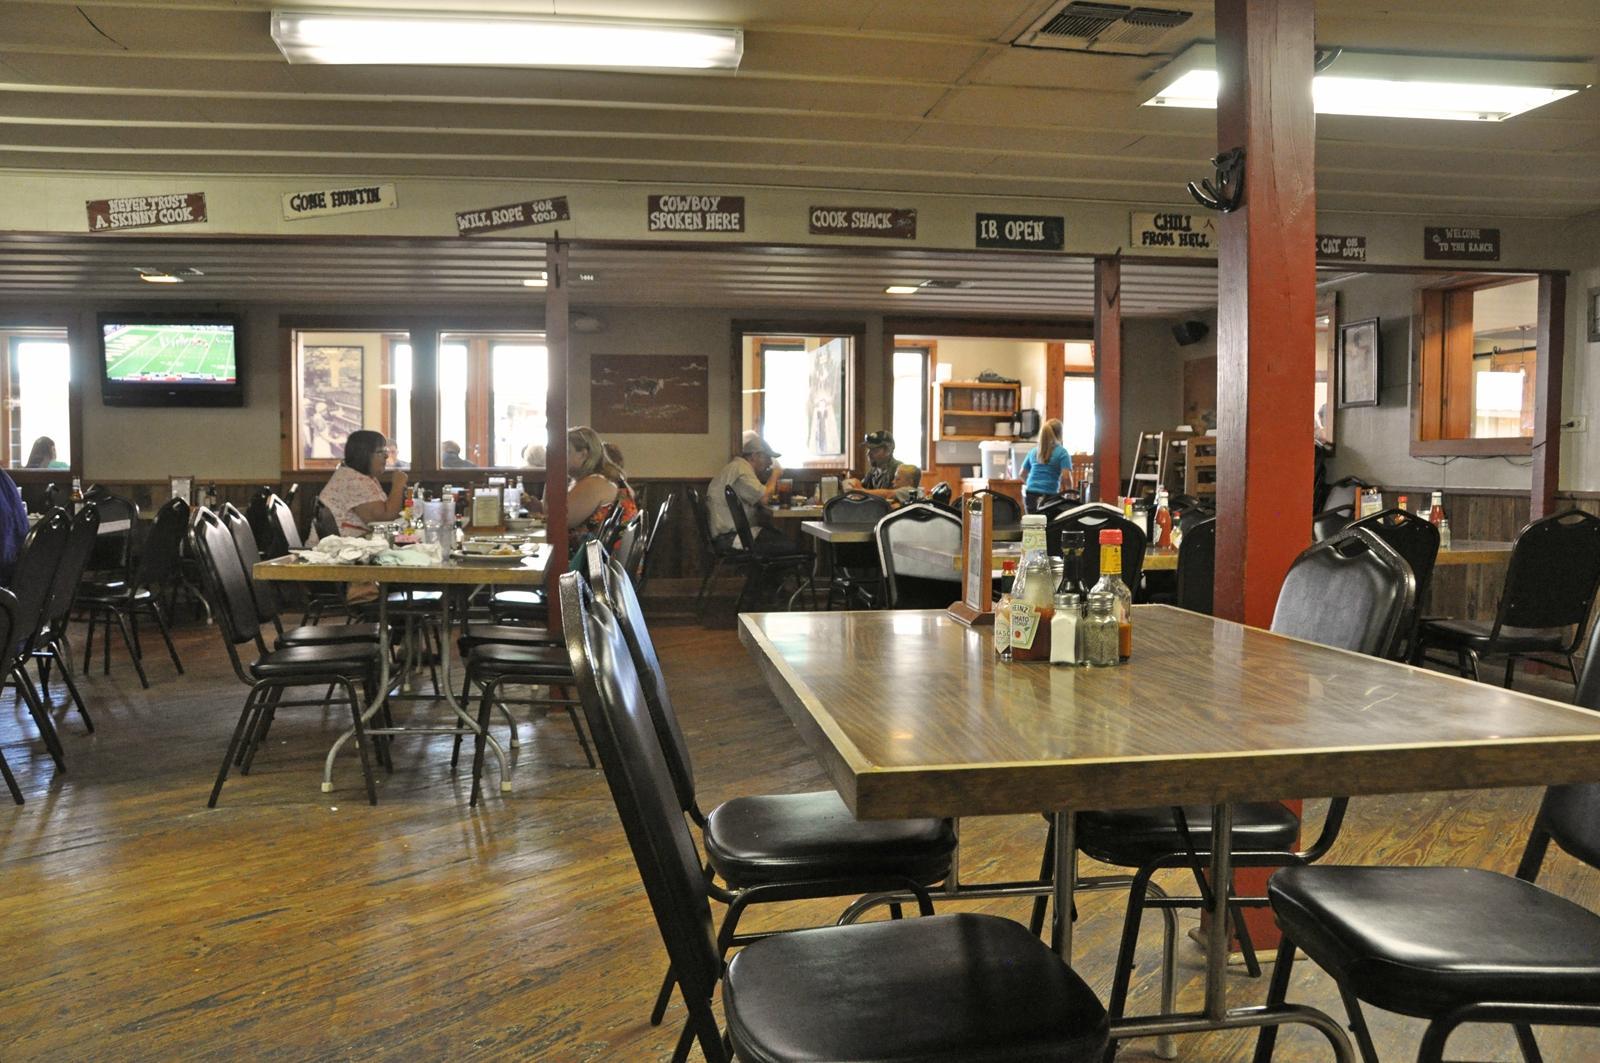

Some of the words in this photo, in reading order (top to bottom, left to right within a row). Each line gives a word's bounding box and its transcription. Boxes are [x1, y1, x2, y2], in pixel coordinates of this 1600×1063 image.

[108, 197, 149, 213] NEVER
[148, 194, 188, 211] TRUST
[290, 192, 327, 212] GONE
[330, 187, 381, 208] HUNTIN
[532, 200, 553, 212] FOR
[659, 196, 720, 212] COWBOY
[95, 215, 109, 229] A
[109, 210, 158, 228] SKINNY
[159, 207, 194, 224] COOK
[457, 212, 491, 230] WILL
[492, 205, 524, 225] ROPE
[531, 211, 557, 223] FOOD
[650, 211, 703, 230] SPOKEN
[705, 212, 740, 230] HERE
[812, 210, 848, 228] COOK
[851, 211, 893, 229] SHACK
[1153, 213, 1192, 232] CHILI
[1004, 220, 1045, 241] OPEN
[1142, 230, 1175, 246] FROM
[1178, 232, 1209, 248] HELL
[1445, 228, 1481, 239] WELCOME
[1321, 238, 1341, 254] CAT
[1343, 247, 1365, 258] DUTY
[1438, 242, 1449, 252] TO
[1451, 242, 1466, 252] THE
[1468, 242, 1494, 253] RANCH
